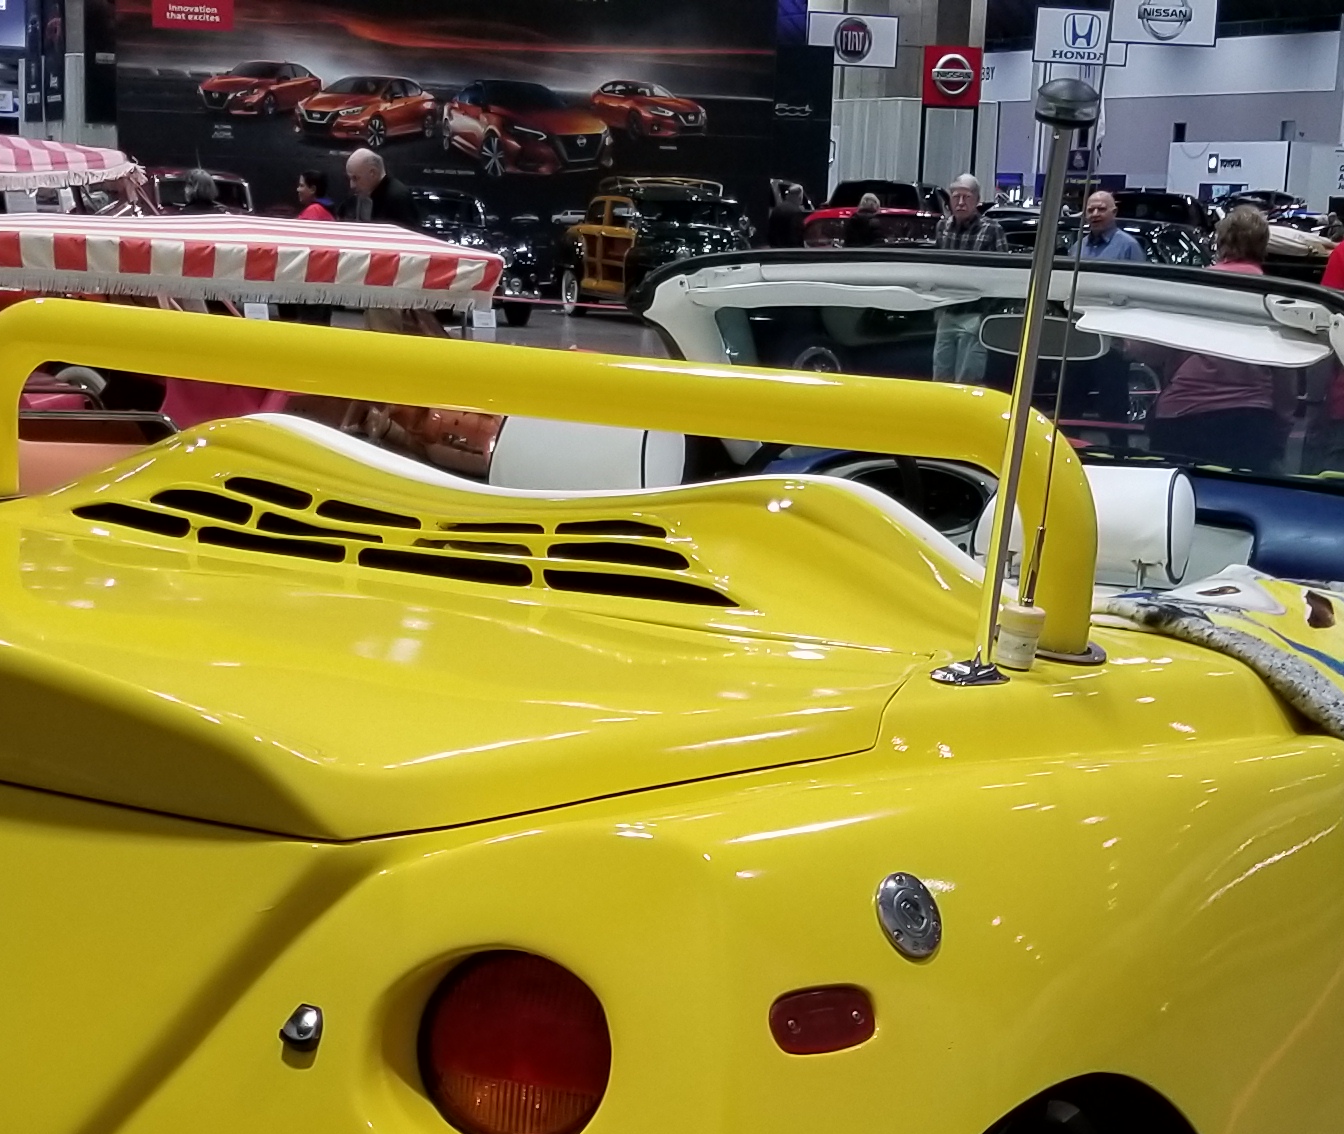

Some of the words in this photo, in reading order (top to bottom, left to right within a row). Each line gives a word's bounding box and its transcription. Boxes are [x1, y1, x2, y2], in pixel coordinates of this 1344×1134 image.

[168, 4, 217, 13] Innovation
[1143, 8, 1188, 18] NISSAN
[166, 12, 186, 20] that
[188, 13, 220, 22] excites
[842, 31, 864, 51] FIAT
[936, 70, 971, 79] NISSAN
